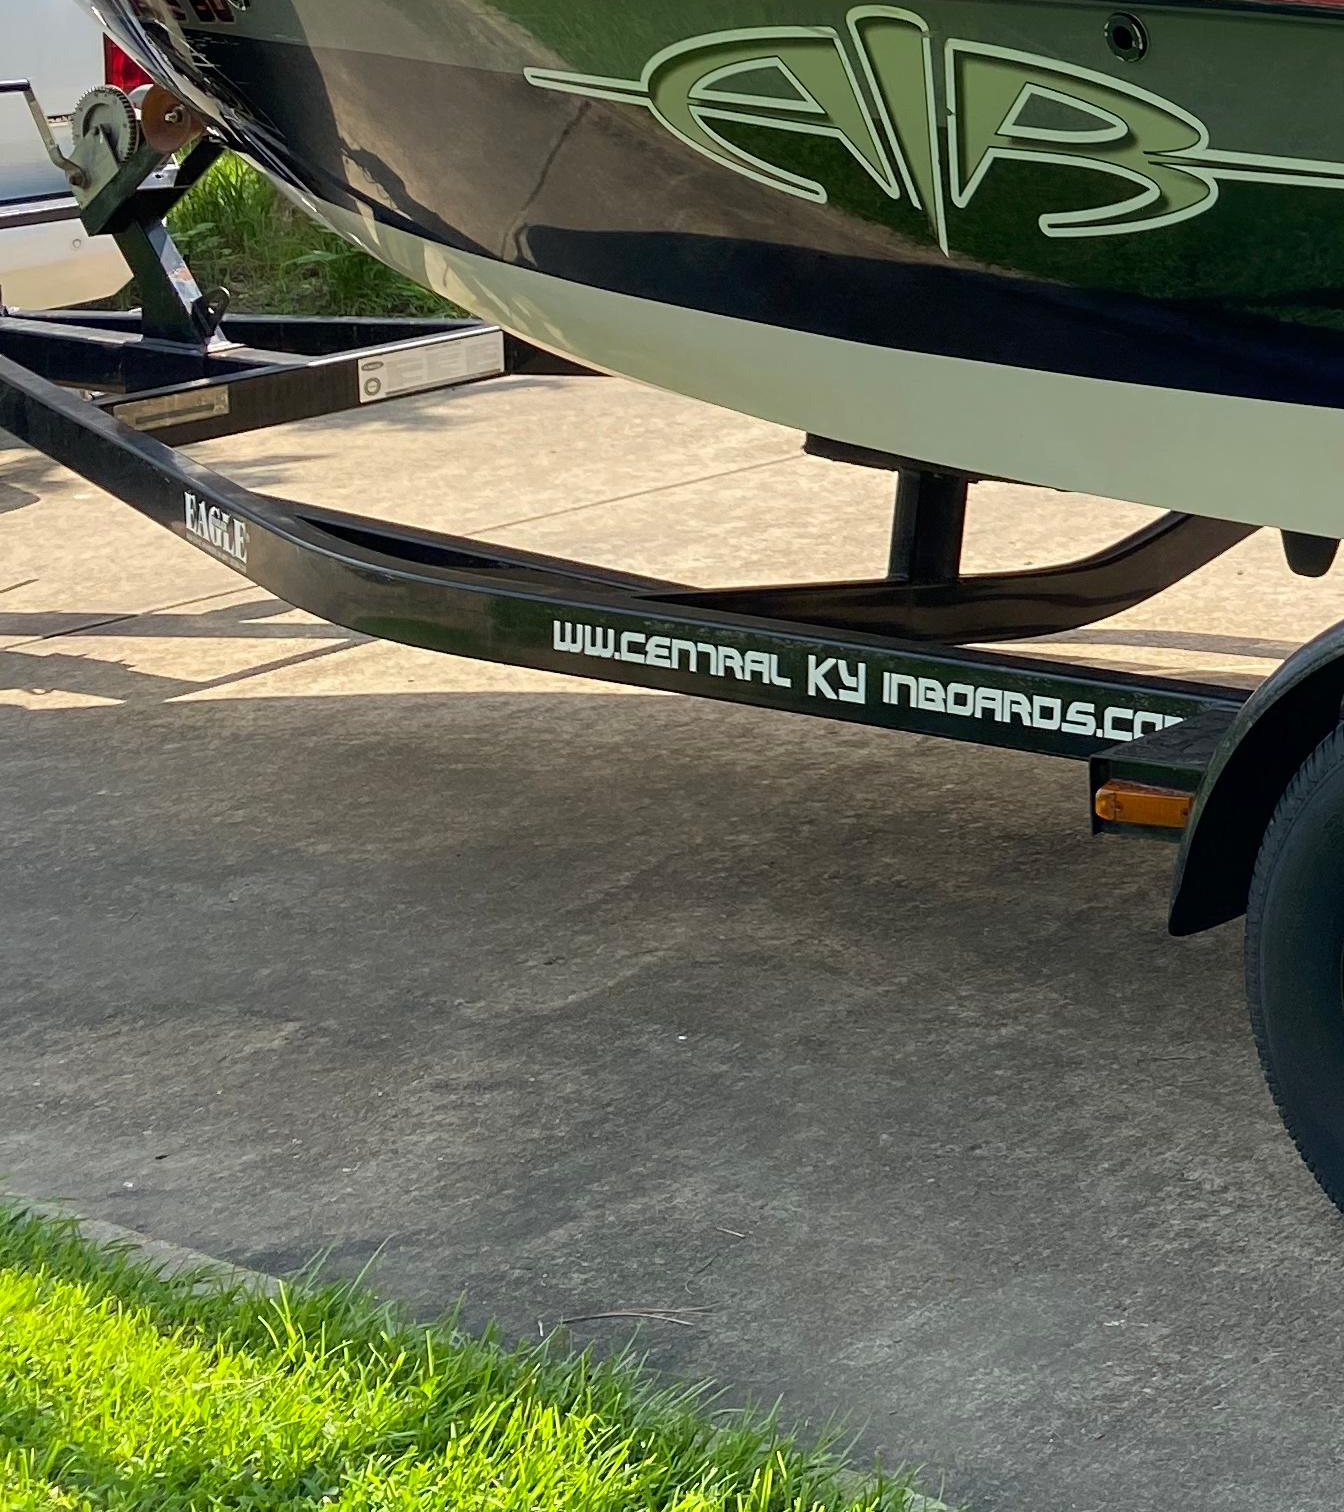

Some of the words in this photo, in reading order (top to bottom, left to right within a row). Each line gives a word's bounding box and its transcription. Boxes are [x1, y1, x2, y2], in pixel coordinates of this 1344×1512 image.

[184, 490, 249, 565] EAGLE
[553, 619, 792, 688] WW.CENTRAL
[807, 654, 867, 704] KY
[882, 671, 1184, 742] INBOARDS.CO
